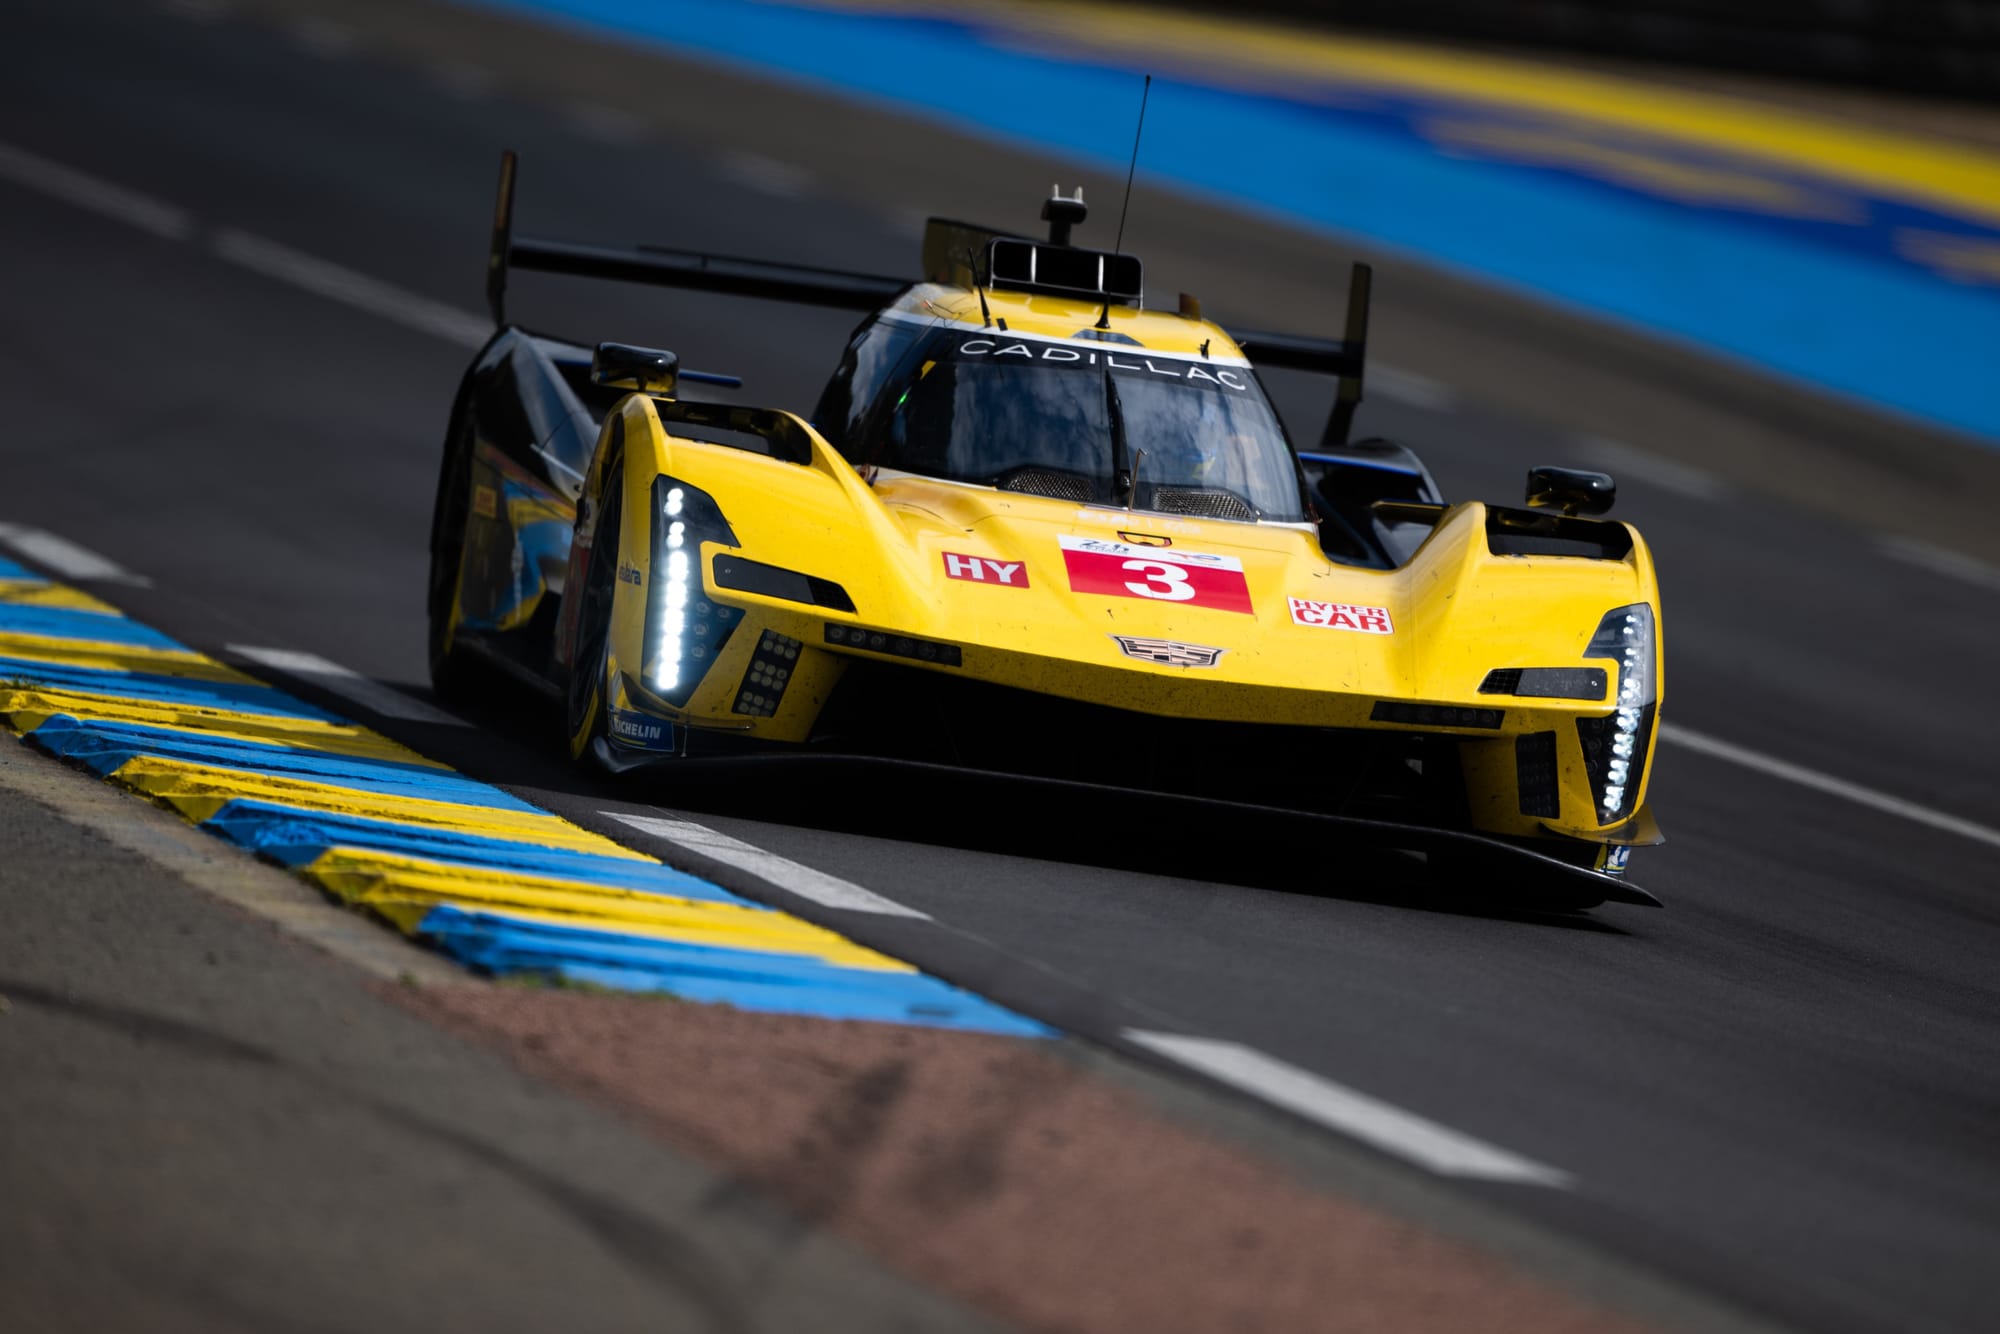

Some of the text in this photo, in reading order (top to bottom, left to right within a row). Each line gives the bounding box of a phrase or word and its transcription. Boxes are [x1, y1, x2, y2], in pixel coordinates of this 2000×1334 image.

[960, 340, 1246, 390] CADILLAC
[946, 554, 1020, 584] HY
[1122, 560, 1196, 601] 3
[1294, 600, 1384, 616] HYPER
[1296, 609, 1388, 631] CAR
